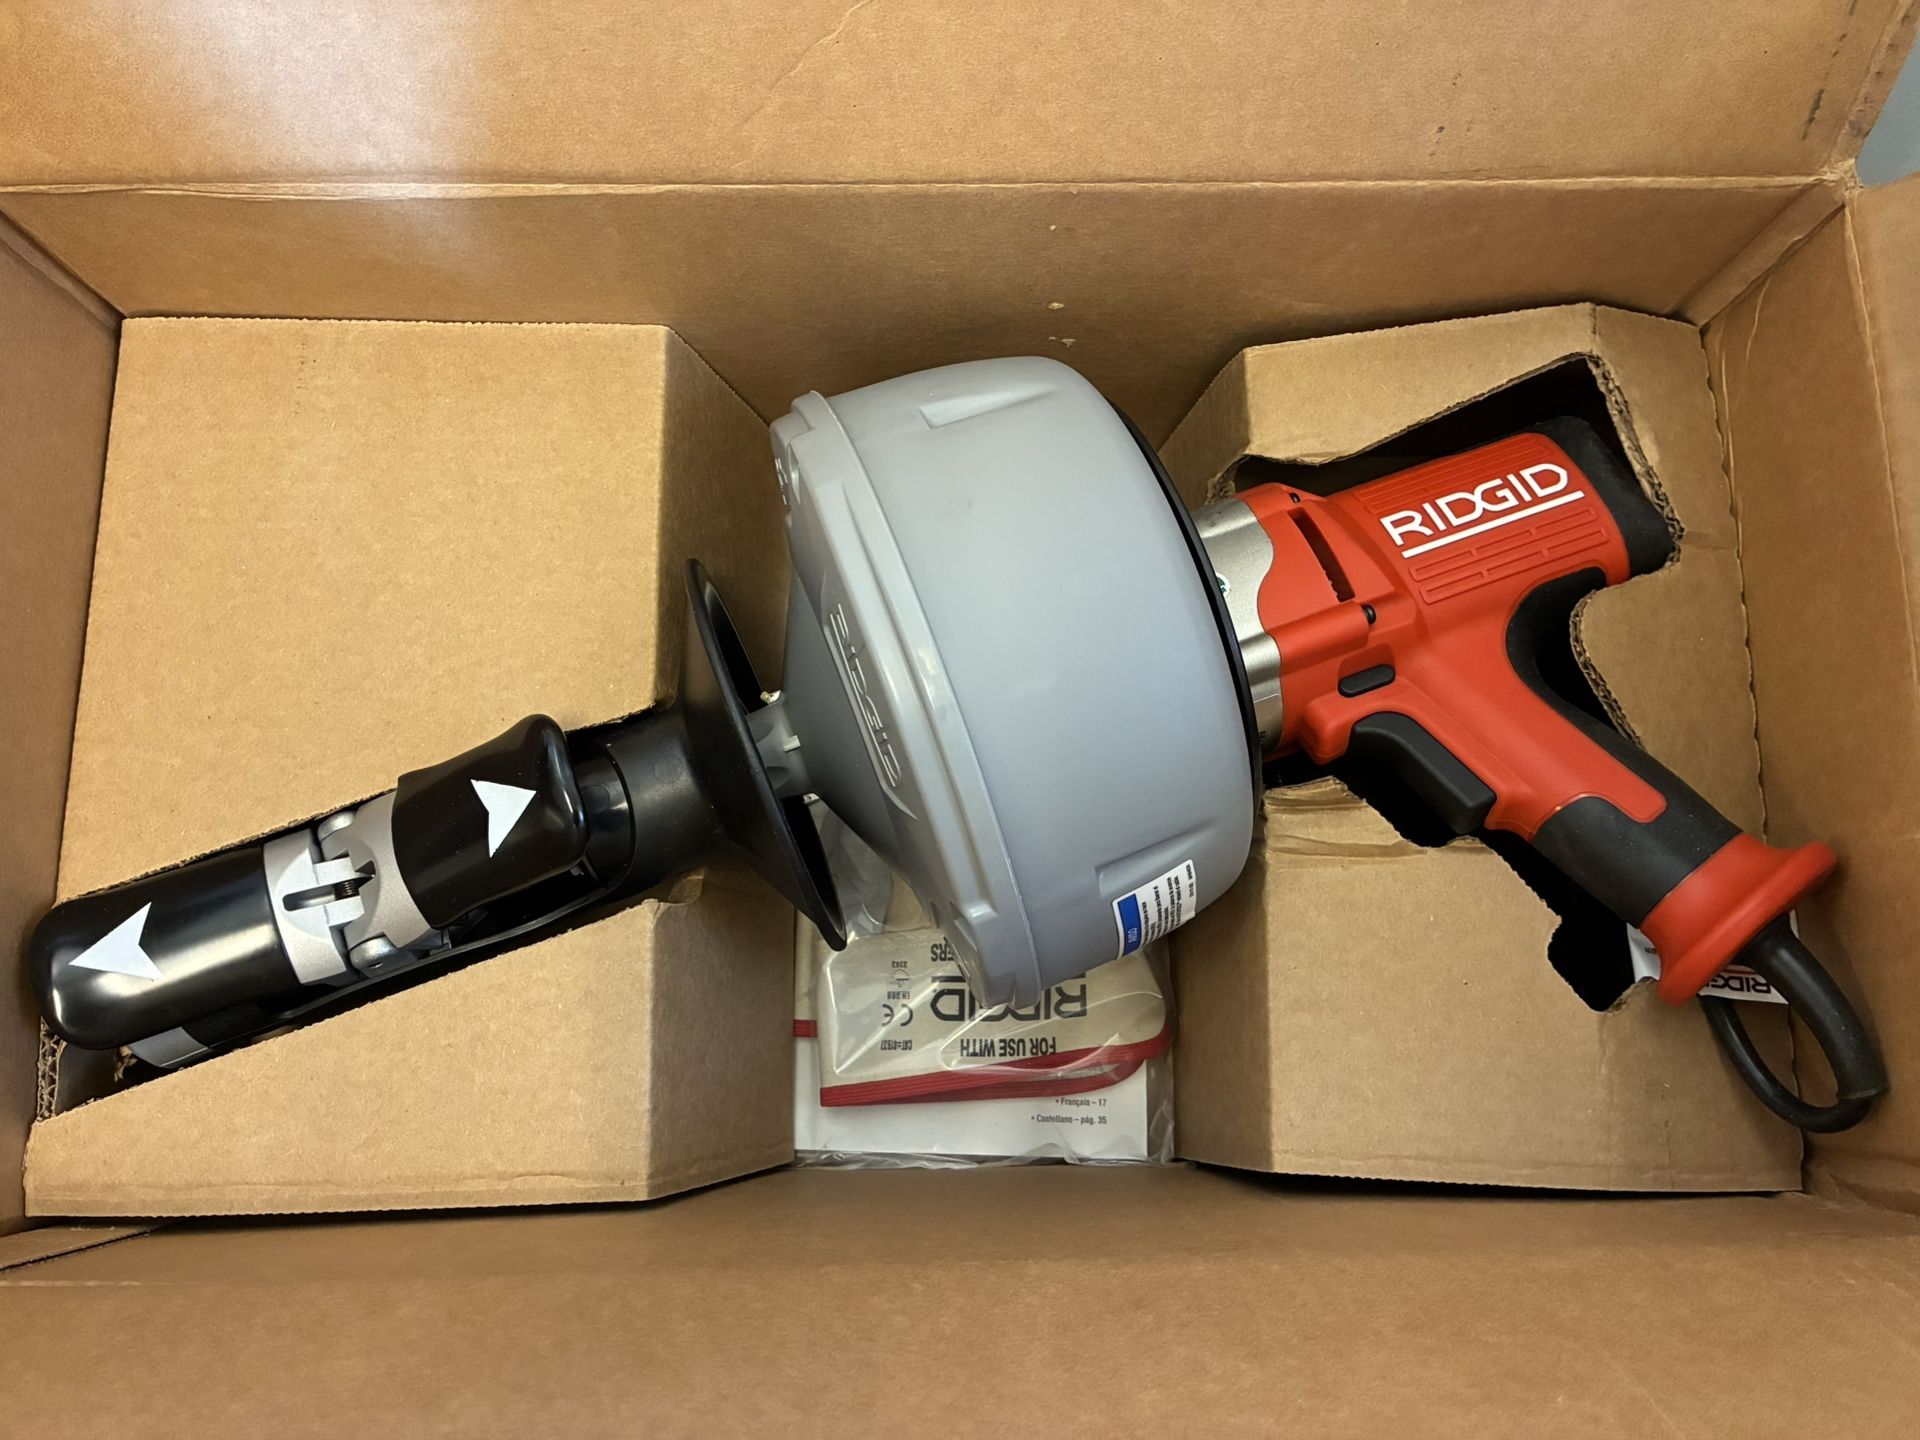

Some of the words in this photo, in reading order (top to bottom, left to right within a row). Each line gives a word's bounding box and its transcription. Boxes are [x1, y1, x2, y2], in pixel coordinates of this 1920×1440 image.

[1379, 463, 1569, 546] RIDGID
[1704, 975, 1771, 994] RIDG
[960, 1038, 996, 1058] WITH
[998, 1038, 1027, 1057] USE
[1030, 1036, 1056, 1057] FOR
[1060, 1097, 1090, 1108] Français
[1098, 1098, 1107, 1107] 17
[1036, 1114, 1073, 1123] Castellano
[1098, 1116, 1107, 1124] 35
